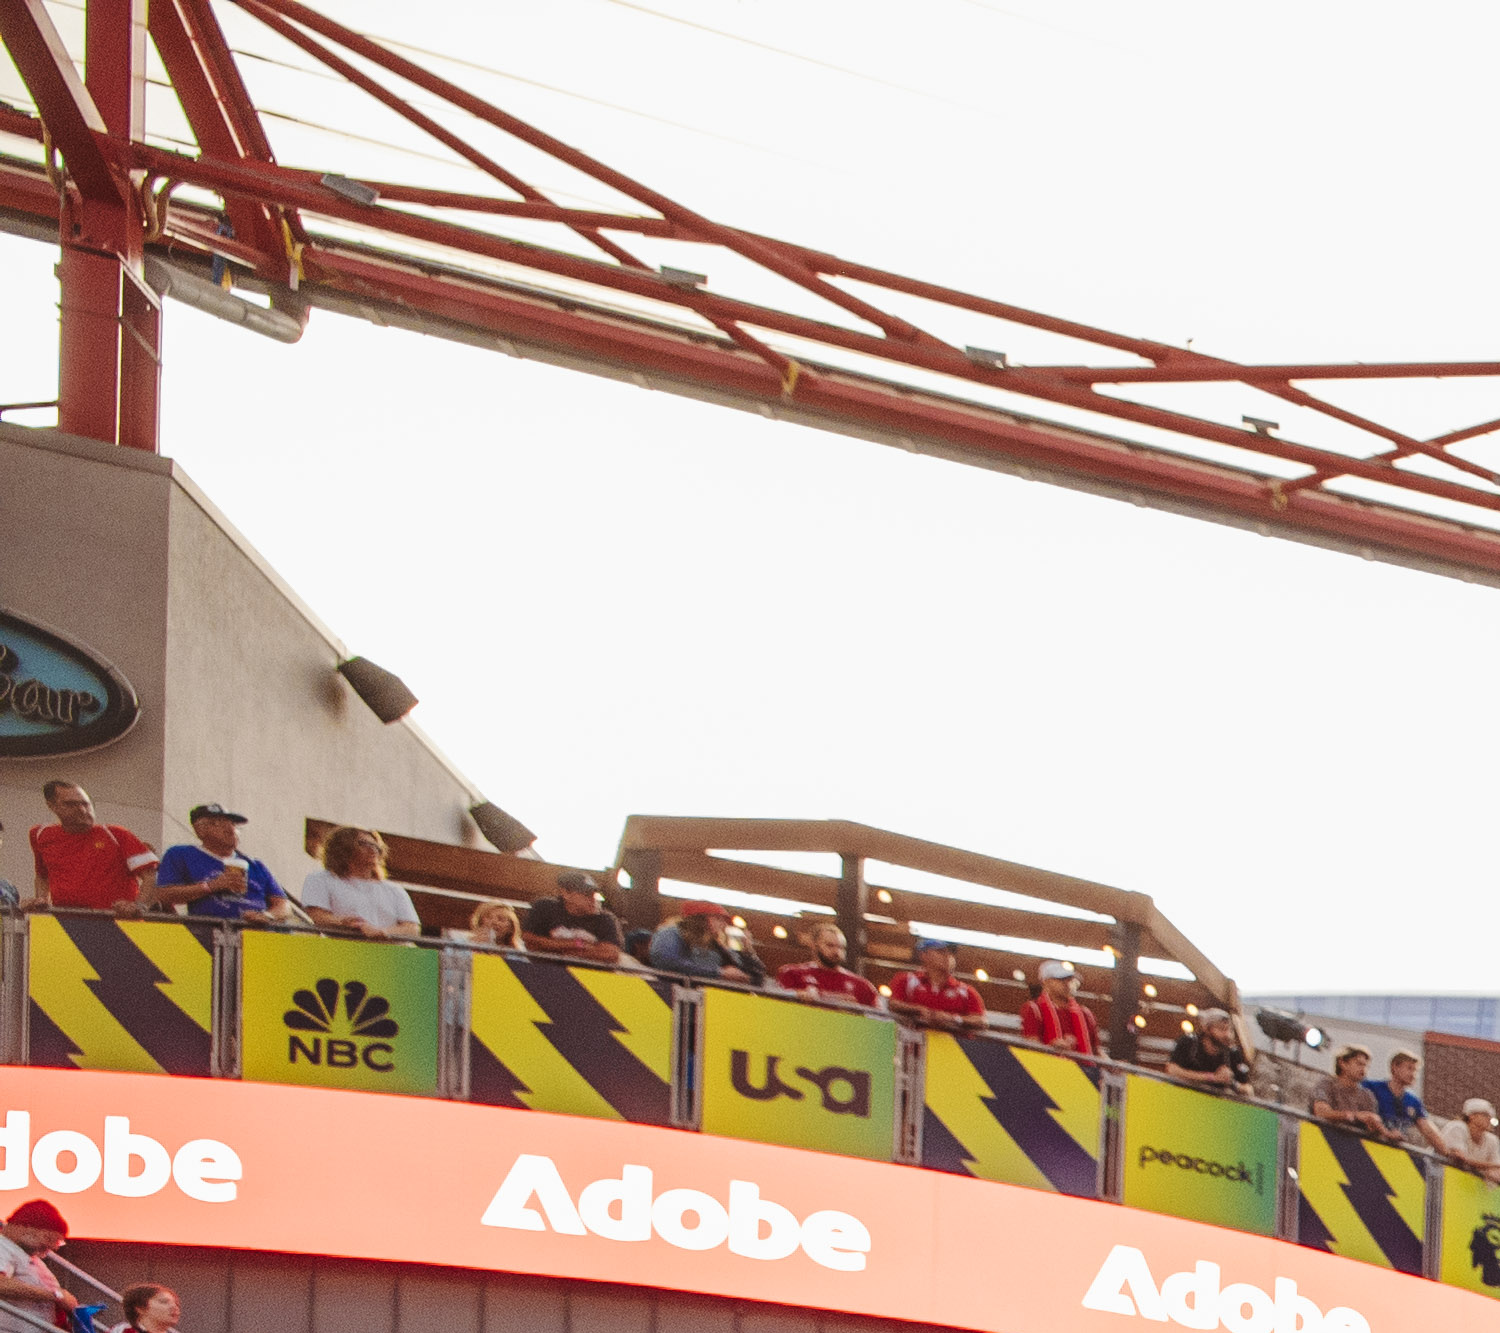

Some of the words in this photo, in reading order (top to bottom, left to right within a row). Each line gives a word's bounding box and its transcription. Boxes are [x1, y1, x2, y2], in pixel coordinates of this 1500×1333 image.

[288, 1034, 395, 1073] NBC
[1138, 1143, 1255, 1189] peacock
[480, 1153, 872, 1272] Adobe
